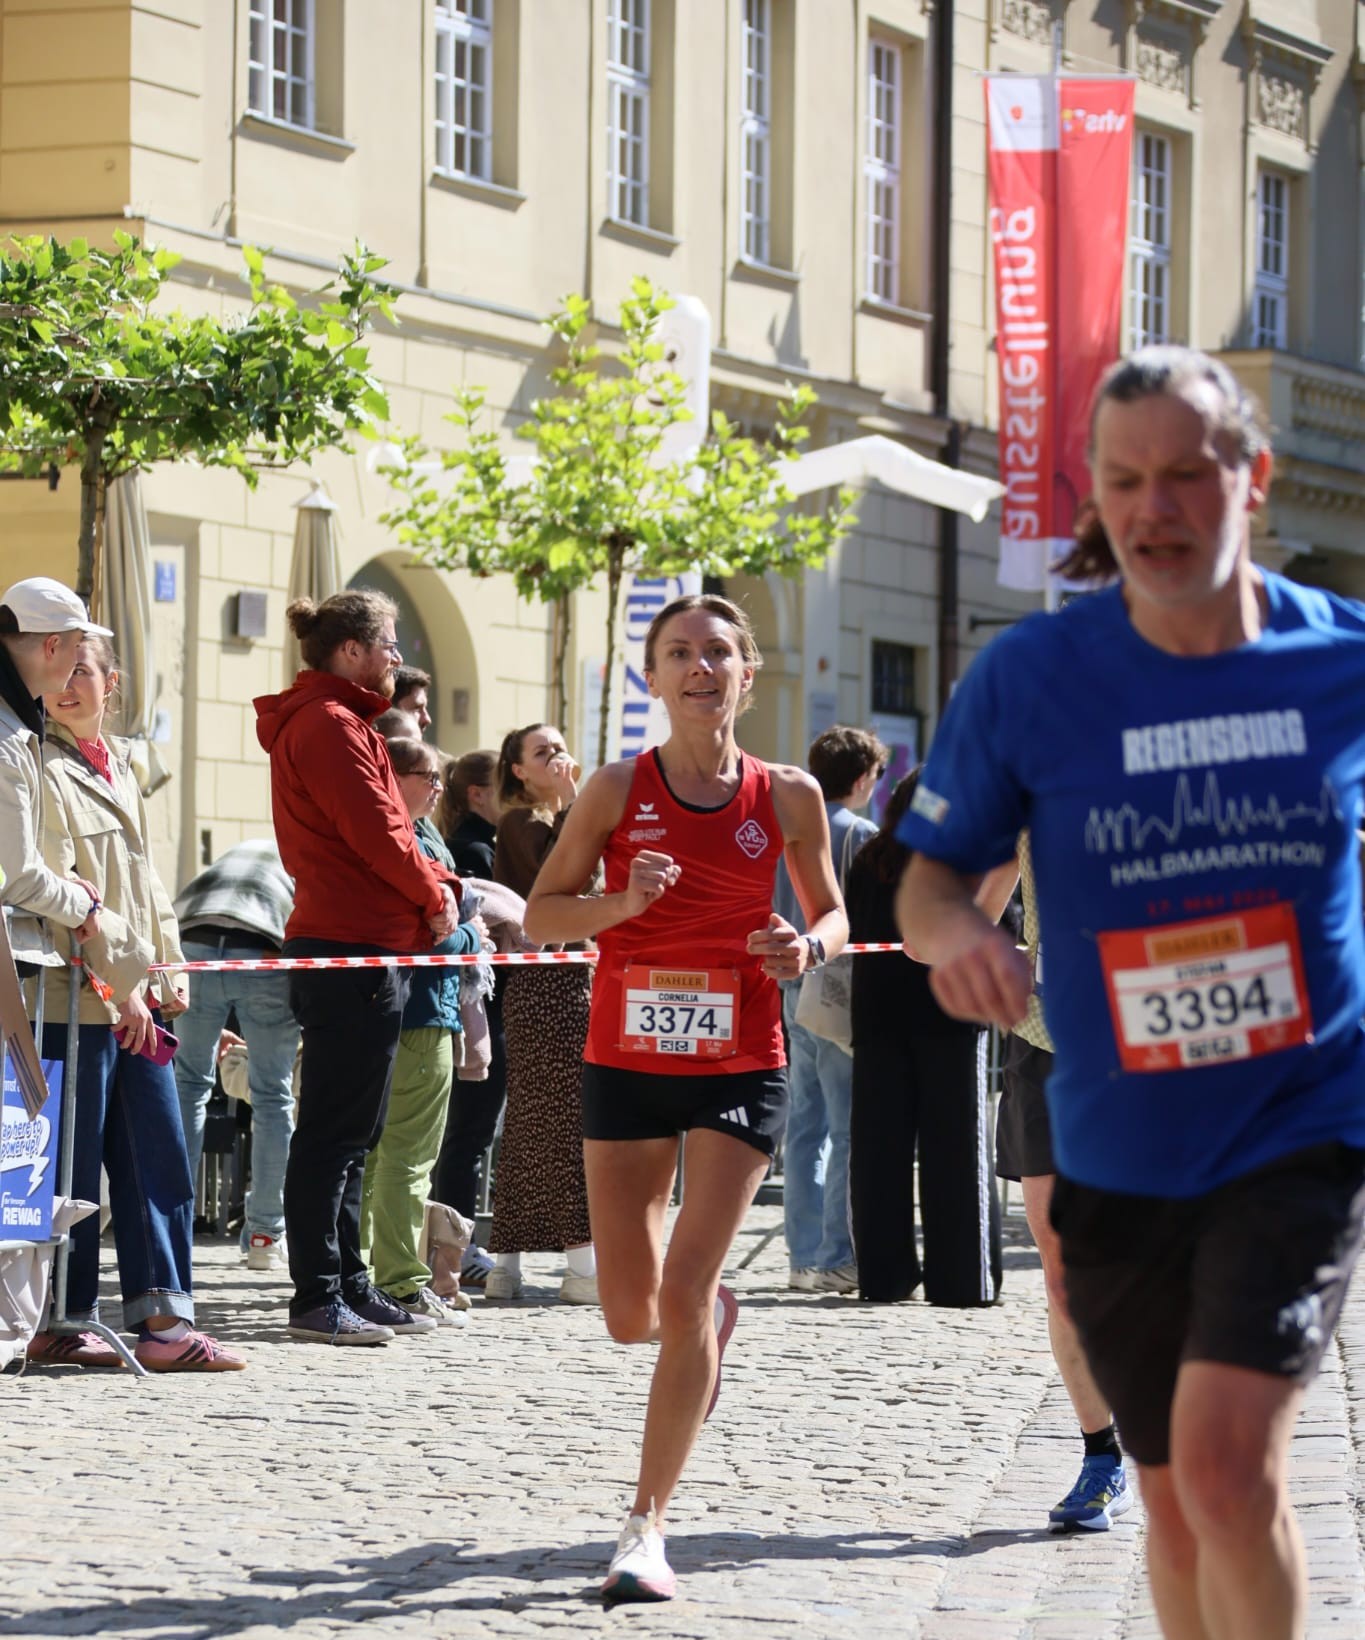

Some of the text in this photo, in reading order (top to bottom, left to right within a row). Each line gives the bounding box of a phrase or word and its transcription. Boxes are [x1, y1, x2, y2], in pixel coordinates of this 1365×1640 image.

[1122, 709, 1307, 776] REGENSBURG
[1110, 841, 1326, 888] HALBMARATHON
[655, 975, 704, 987] DAHLER
[658, 993, 699, 1002] CORNELIA
[1143, 974, 1273, 1036] 3394
[640, 1005, 718, 1036] 3374
[2, 1123, 12, 1139] ap
[13, 1120, 31, 1137] here
[3, 1207, 41, 1226] REWAG
